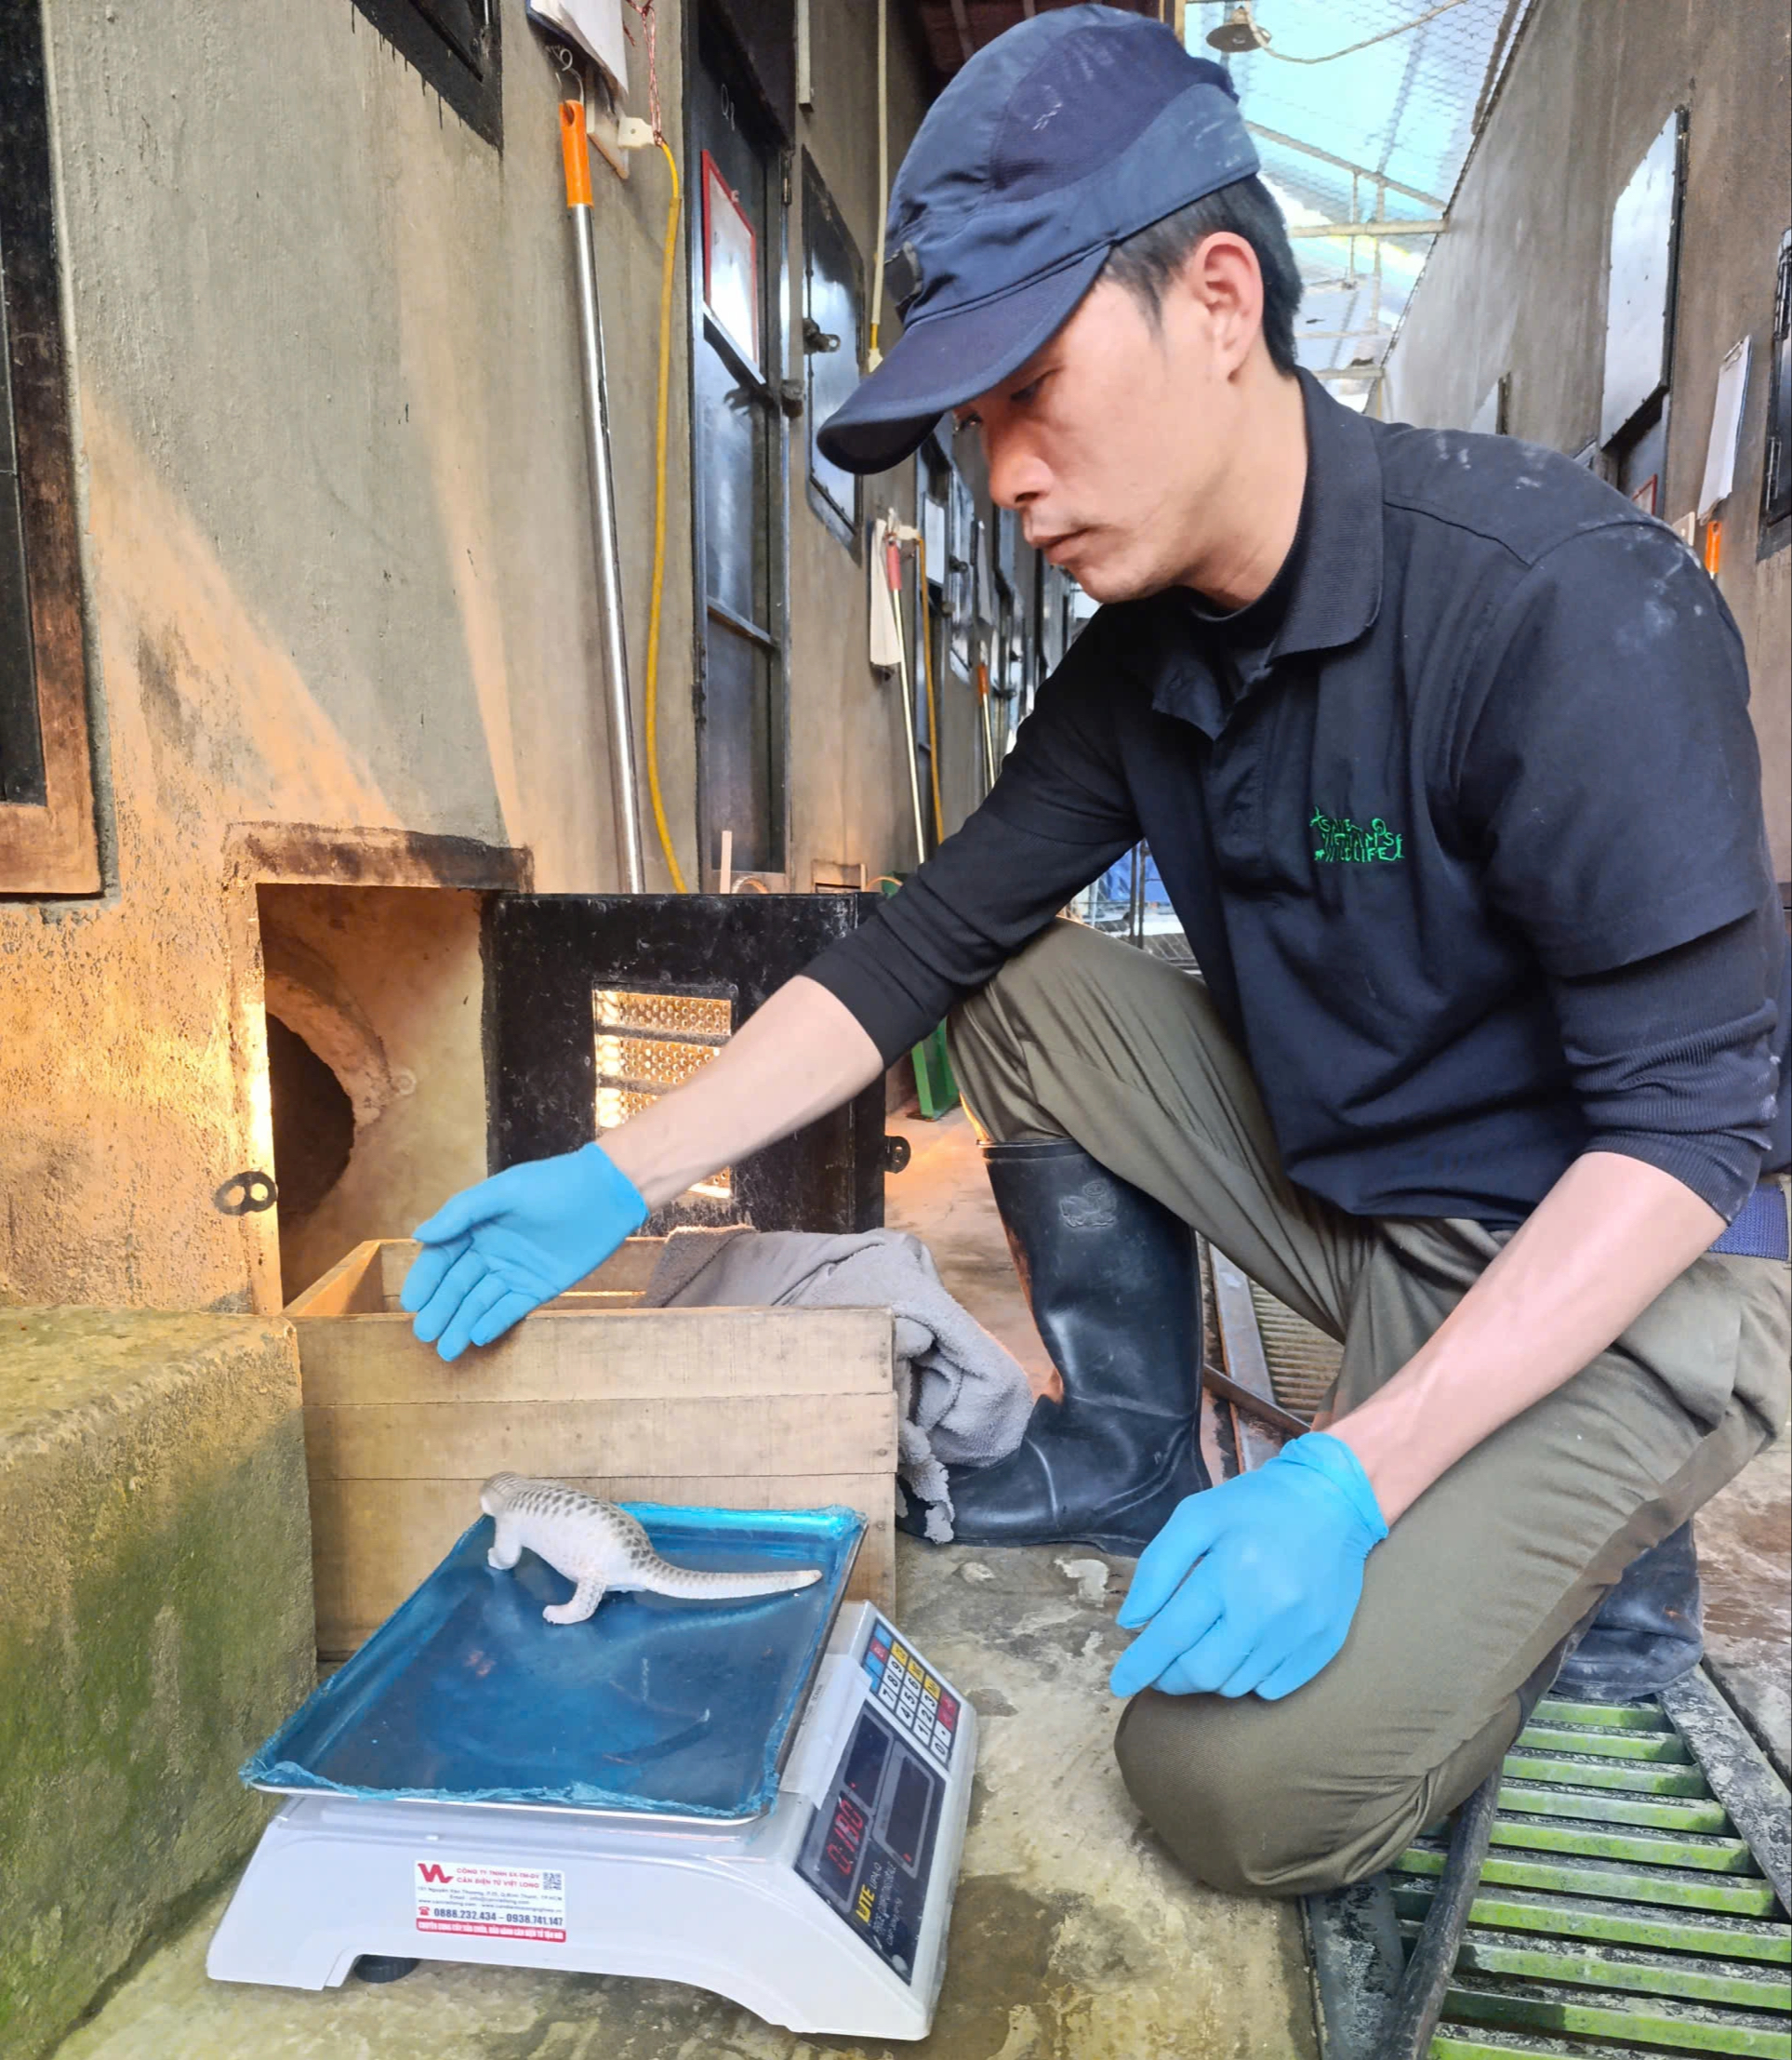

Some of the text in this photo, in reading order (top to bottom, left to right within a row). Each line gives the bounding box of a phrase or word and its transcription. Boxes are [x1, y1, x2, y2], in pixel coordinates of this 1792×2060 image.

[891, 1660, 903, 1673] 9
[887, 1674, 898, 1688] 8
[908, 1677, 920, 1690] 6
[883, 1688, 895, 1702] 7
[904, 1692, 915, 1705] 5
[924, 1695, 936, 1708] 3
[900, 1707, 911, 1720] 4
[921, 1709, 933, 1721] 2
[917, 1724, 929, 1736] 1
[935, 1742, 946, 1756] 0
[433, 1907, 497, 1921] 0888.232.434
[506, 1913, 564, 1926] 0938.741.147
